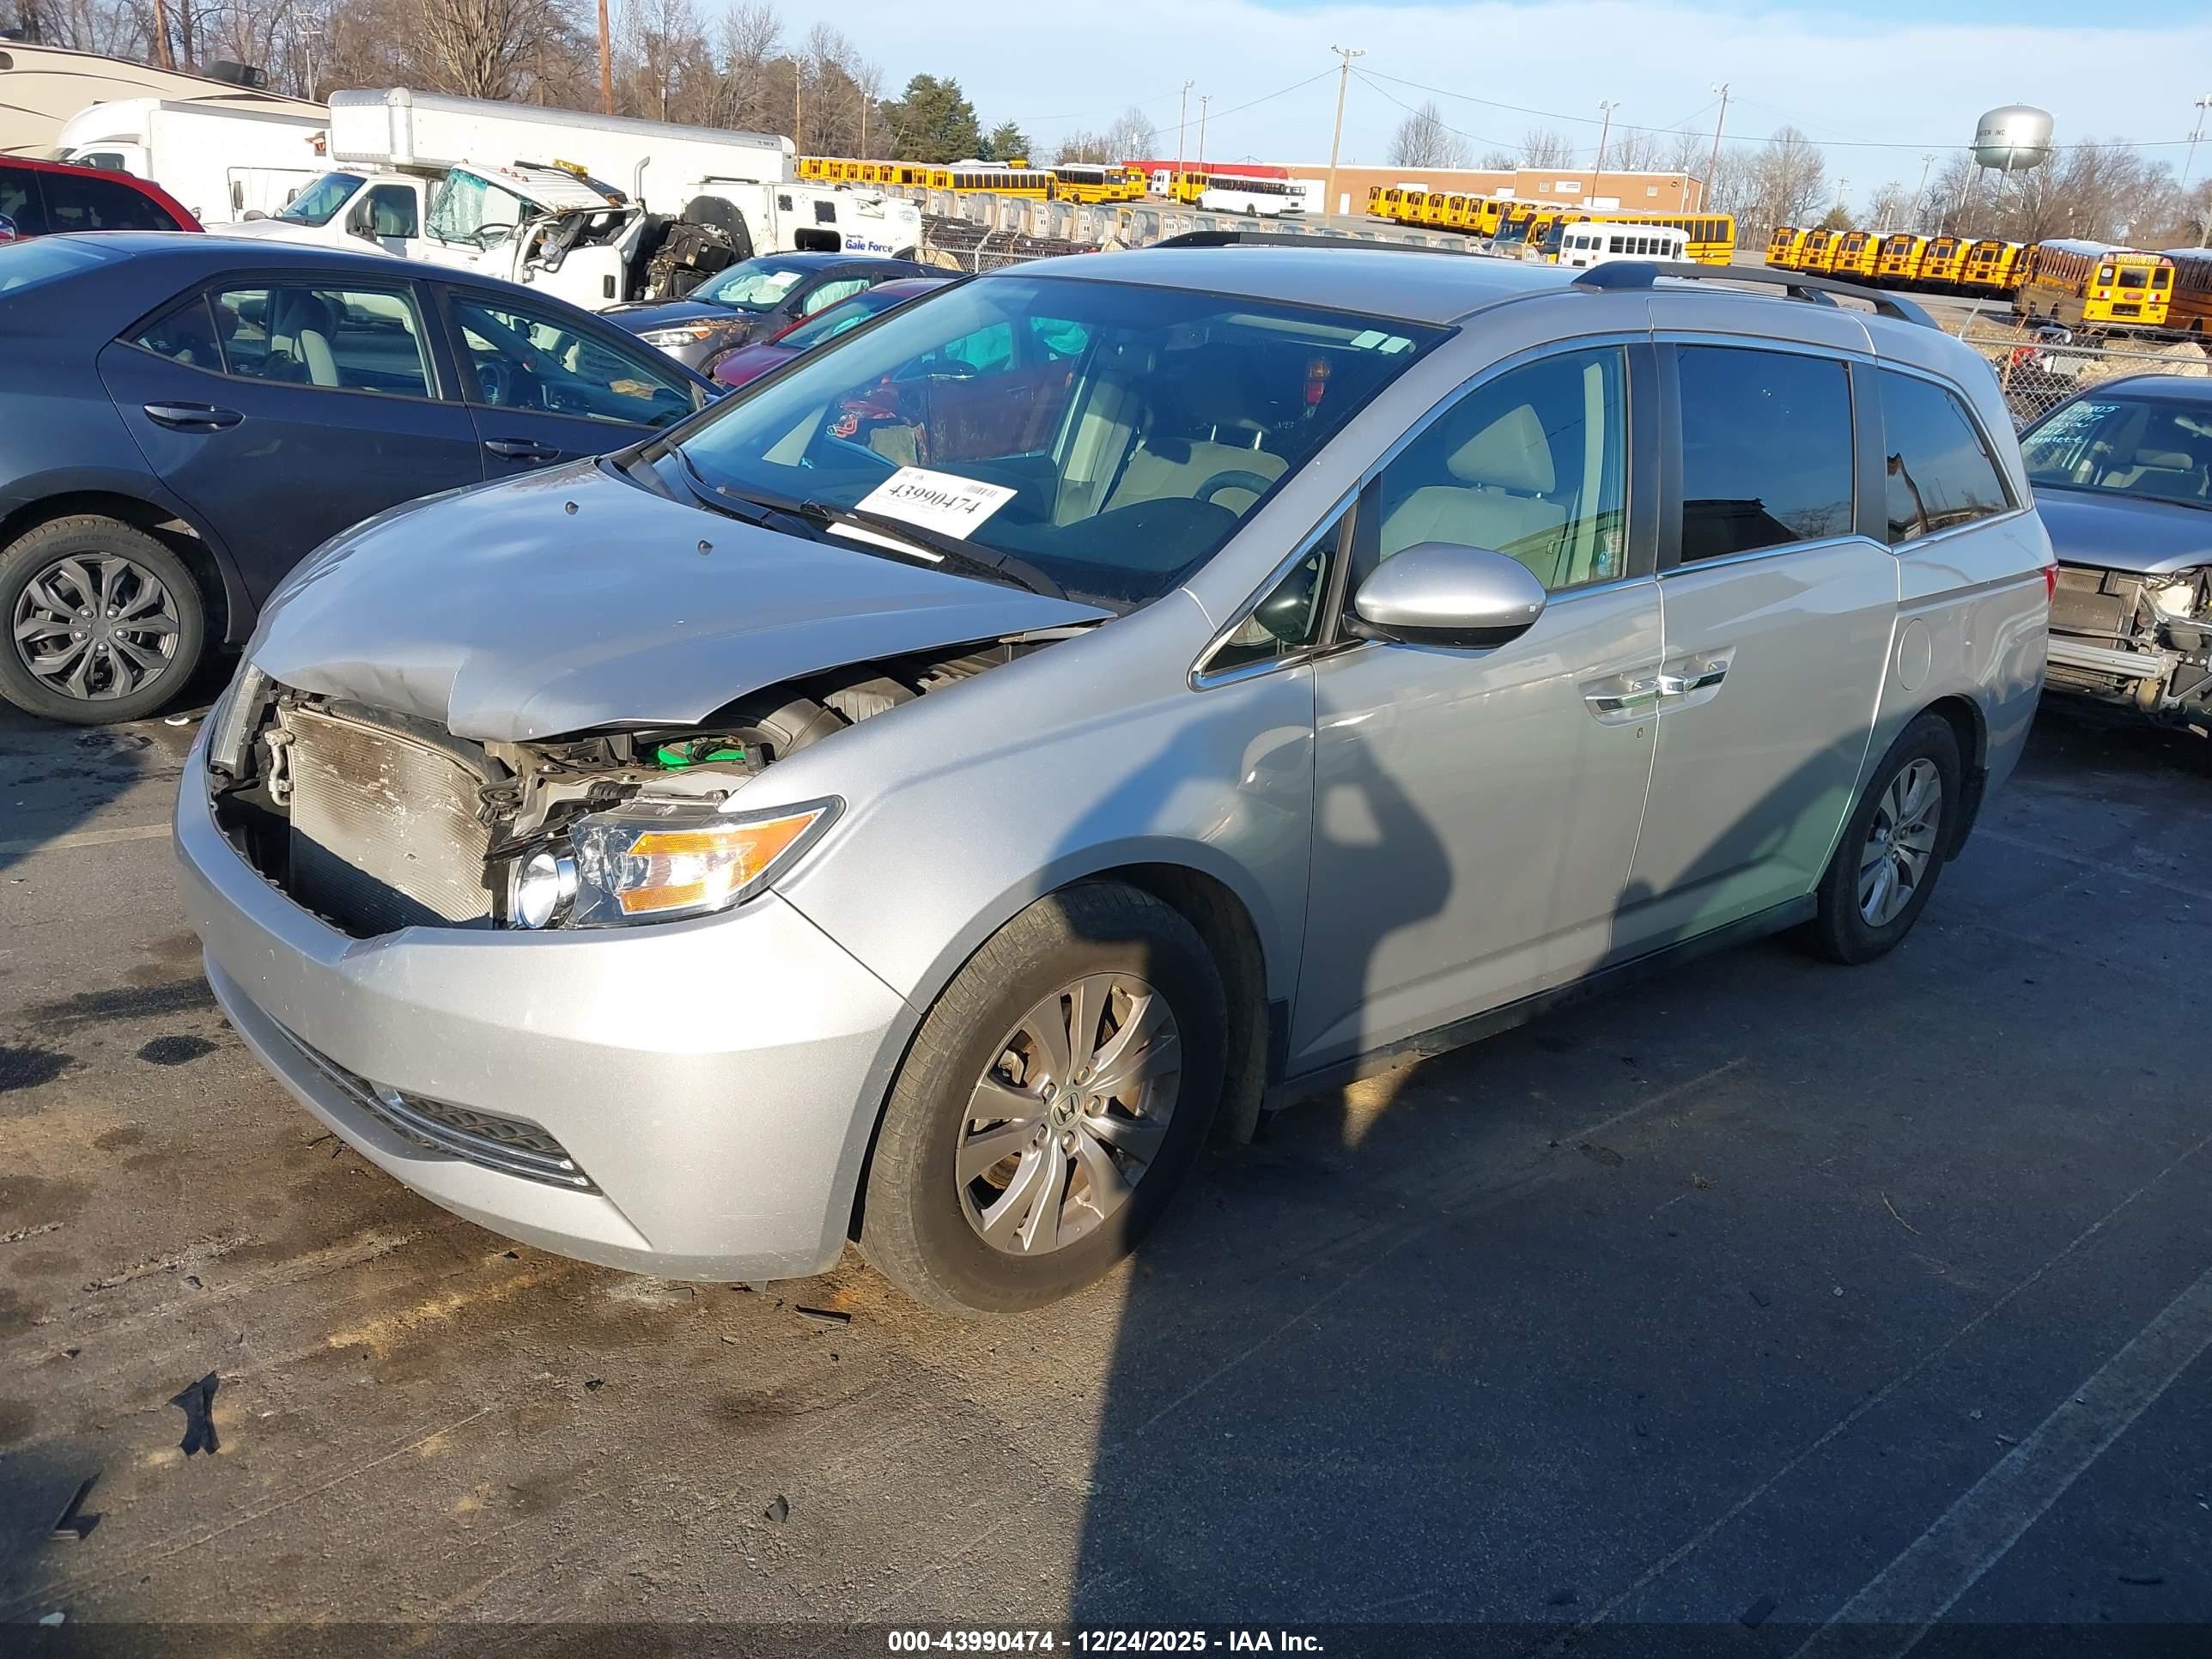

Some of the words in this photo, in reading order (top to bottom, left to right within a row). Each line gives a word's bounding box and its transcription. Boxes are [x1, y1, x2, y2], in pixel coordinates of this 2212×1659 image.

[845, 239, 866, 251] Gale
[868, 241, 893, 253] Force
[2118, 255, 2143, 264] SCHOOL
[2145, 257, 2158, 265] BUS
[889, 483, 981, 514] 43990474
